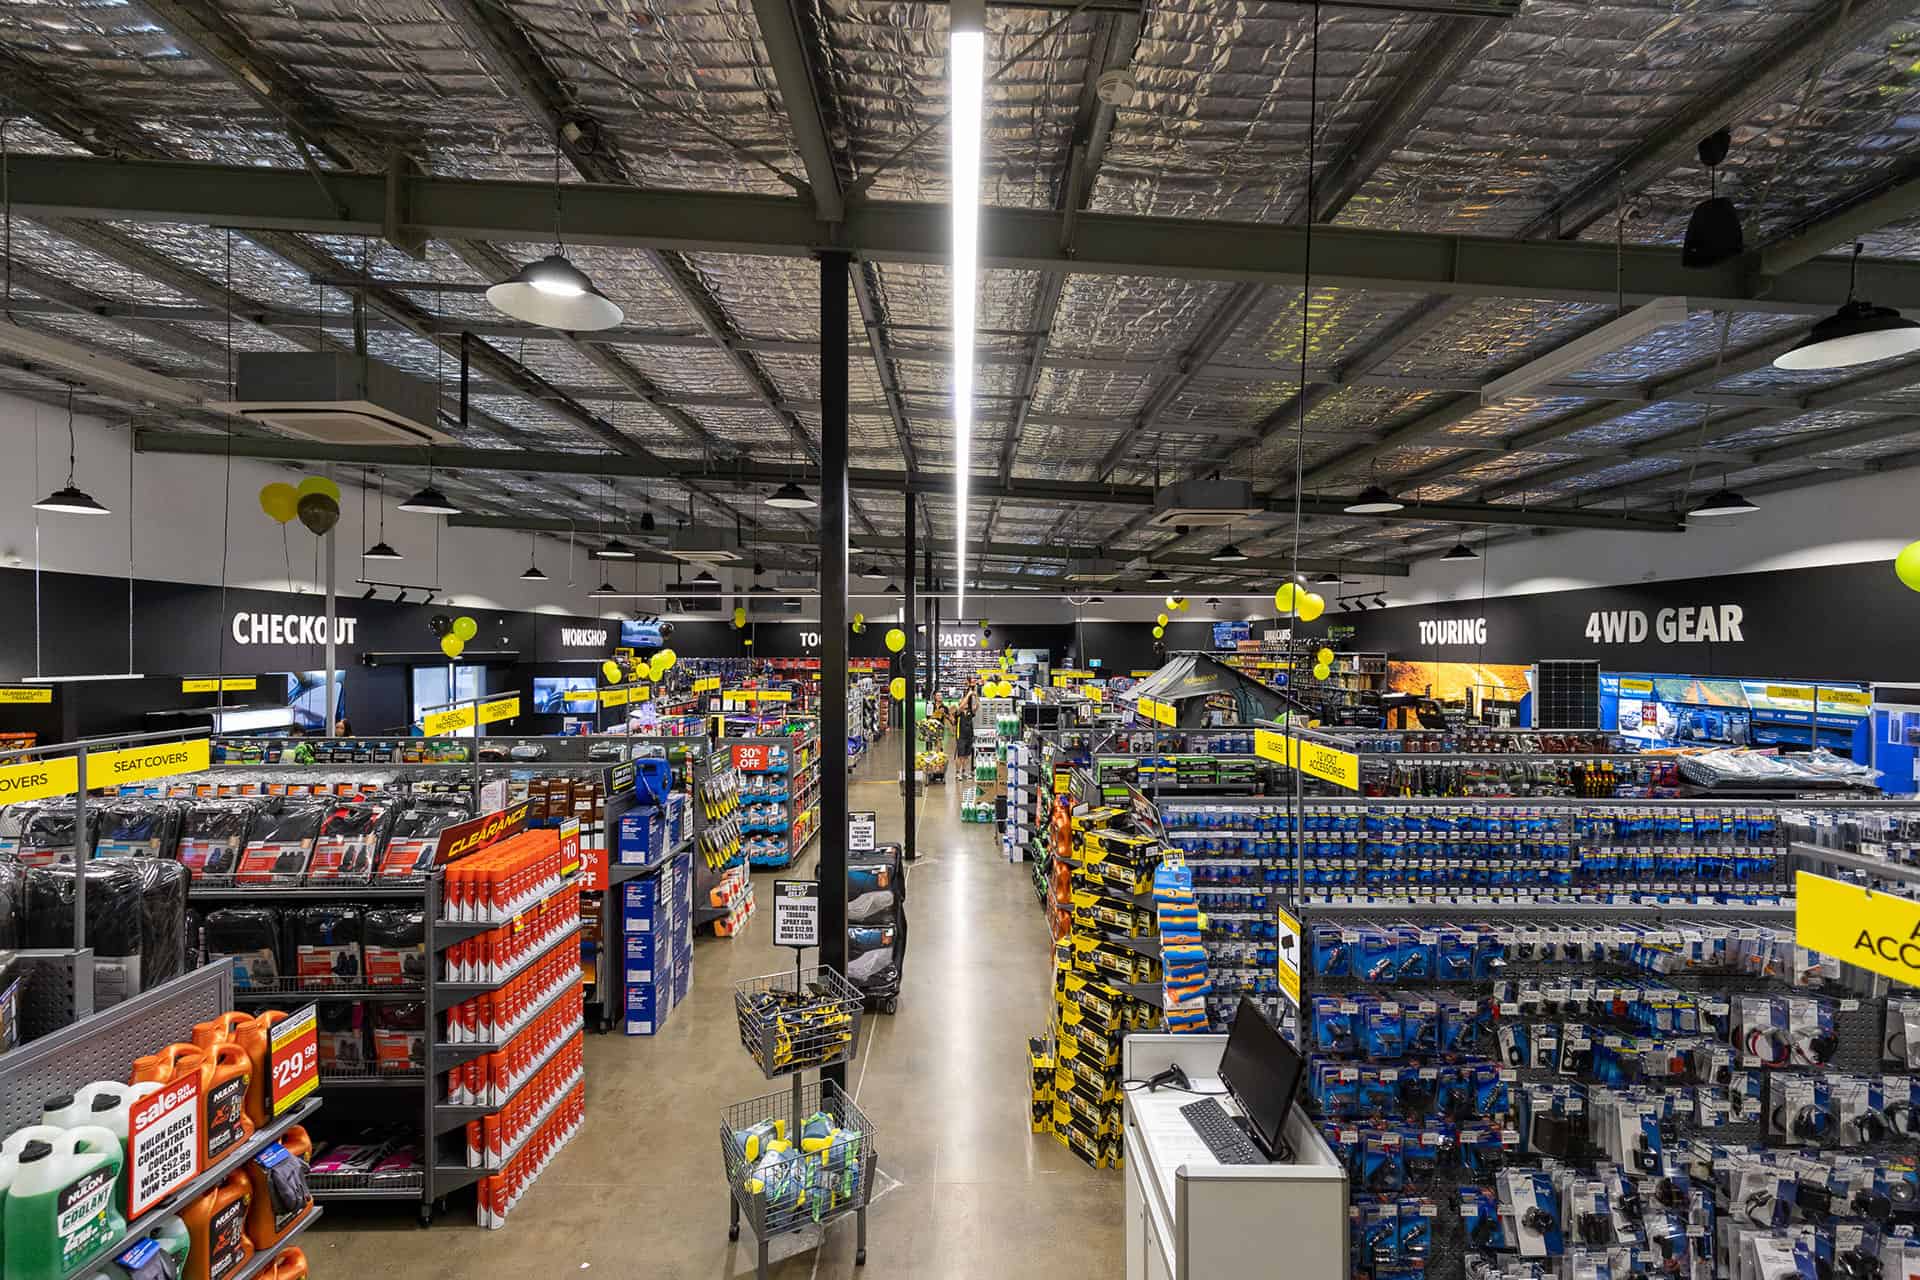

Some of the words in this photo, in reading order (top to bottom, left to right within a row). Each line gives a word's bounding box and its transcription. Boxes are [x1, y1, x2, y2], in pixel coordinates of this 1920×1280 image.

[232, 612, 357, 645] CHECKOUT
[1419, 618, 1487, 646] TOURING
[1585, 610, 1648, 643] 4WD
[1656, 604, 1744, 643] GEAR
[561, 627, 607, 647] WORKSHOP
[800, 632, 821, 647] TO
[939, 633, 977, 647] PARTS
[114, 758, 143, 773] SEAT
[144, 751, 189, 768] COVERS
[740, 747, 761, 759] 30%
[740, 758, 760, 768] OFF
[1310, 759, 1346, 780] ACCESSORIES
[0, 773, 48, 792] OVERS
[448, 804, 529, 858] CLEARANCE
[562, 840, 577, 860] $10
[579, 853, 599, 871] 0%
[578, 872, 597, 886] FF
[1853, 928, 1920, 969] ACC
[176, 1083, 190, 1098] on
[177, 1086, 197, 1103] now
[135, 1089, 178, 1131] sale
[138, 1124, 194, 1167] CONCENTRATE
[140, 1128, 166, 1154] NULON
[167, 1113, 192, 1136] GREEN
[148, 1141, 184, 1172] COOLANT
[140, 1181, 160, 1202] NOW
[161, 1160, 191, 1187] $46.99
[141, 1169, 160, 1190] WAS
[161, 1149, 191, 1176] $52.99
[67, 1174, 104, 1206] NULON
[62, 1186, 111, 1230] COOLANT
